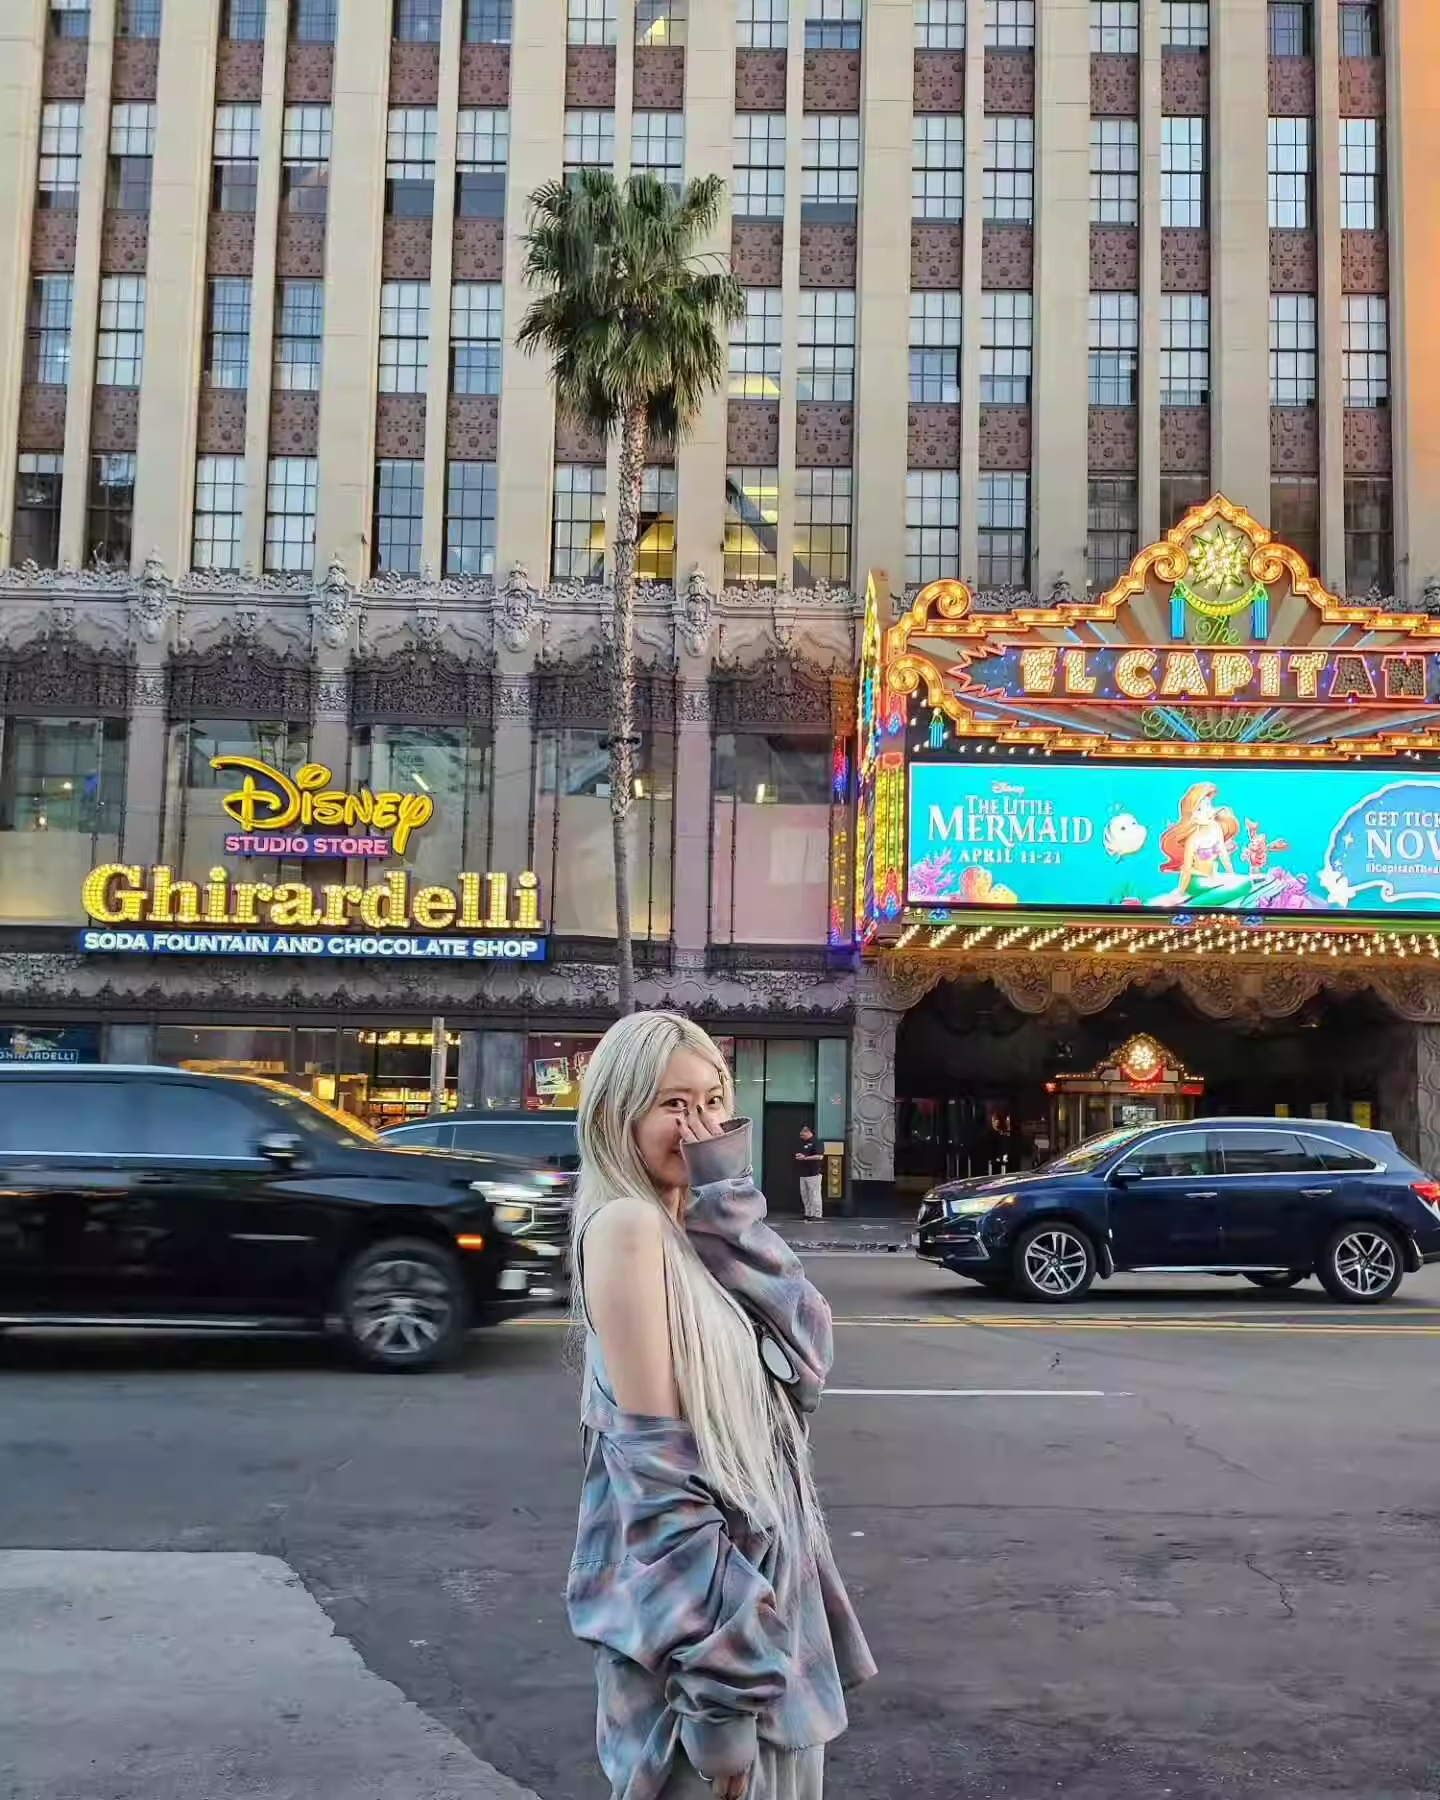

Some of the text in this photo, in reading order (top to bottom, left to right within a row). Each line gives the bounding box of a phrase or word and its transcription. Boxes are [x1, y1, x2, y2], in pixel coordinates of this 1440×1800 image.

[1192, 614, 1241, 646] The
[1021, 648, 1427, 697] EL CAPITAN
[209, 756, 433, 855] Disney
[1365, 811, 1398, 826] GET
[928, 804, 1093, 848] MERMAID
[225, 836, 389, 855] STUDIO STORE
[959, 849, 1062, 864] APRIL 11-21
[83, 864, 542, 929] Ghirardelli
[84, 932, 538, 958] SODA FOUNTAIN AND CHOCOLATE SHOP
